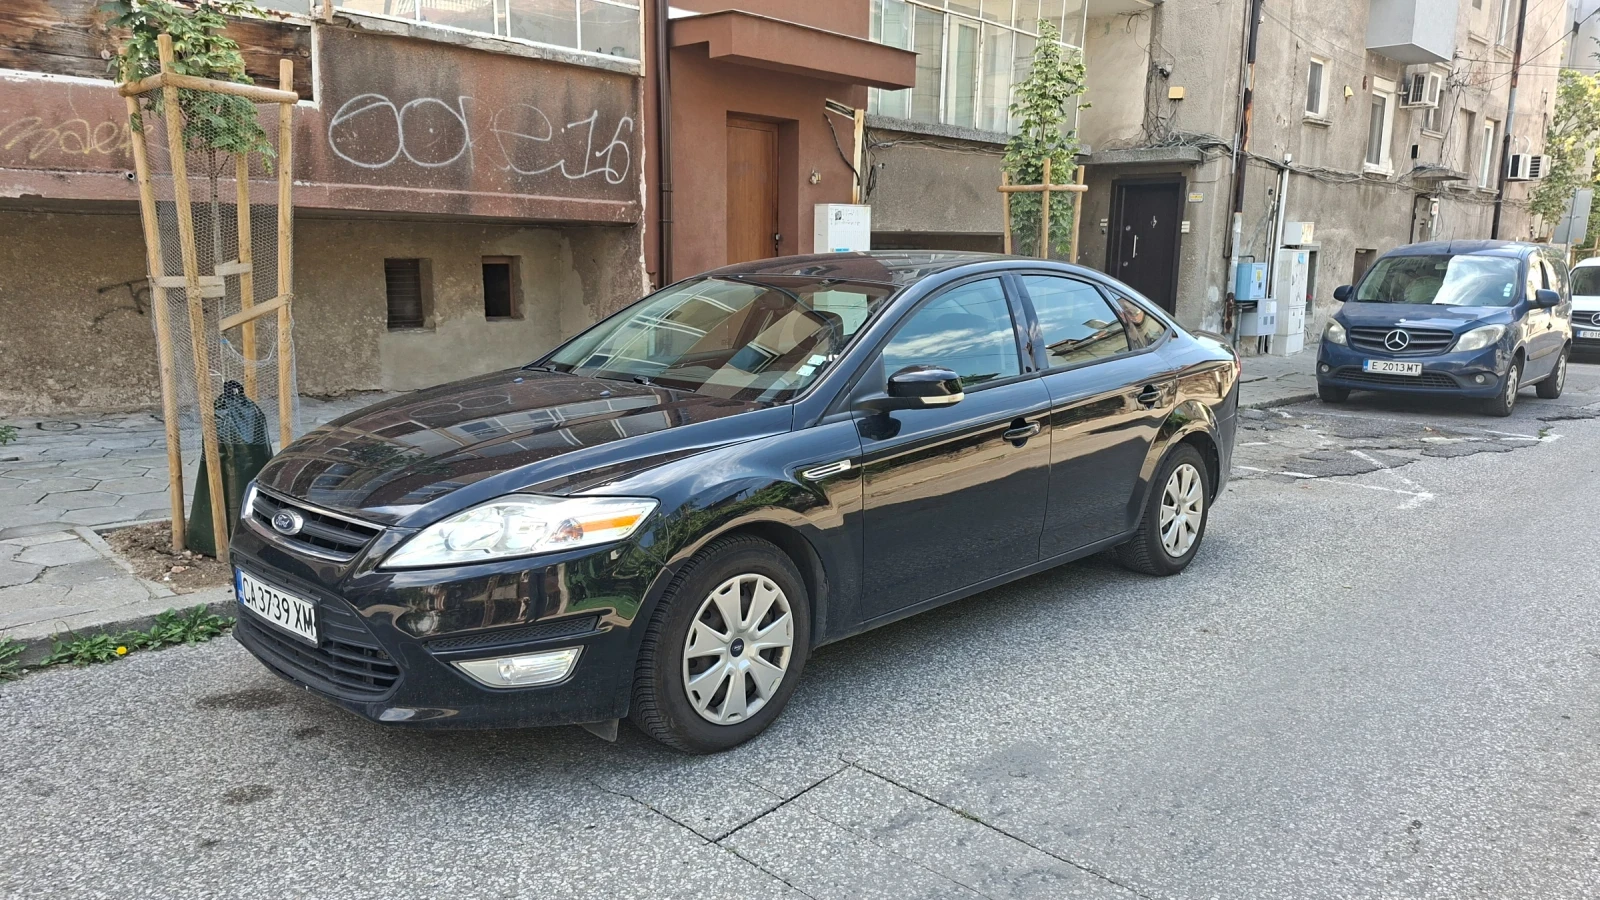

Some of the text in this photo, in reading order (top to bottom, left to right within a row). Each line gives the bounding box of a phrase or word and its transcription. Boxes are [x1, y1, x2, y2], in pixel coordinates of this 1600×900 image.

[1372, 361, 1378, 370] E
[1382, 362, 1405, 371] 2013
[1407, 363, 1420, 372] MT
[275, 514, 290, 528] Ford
[293, 600, 314, 636] XM
